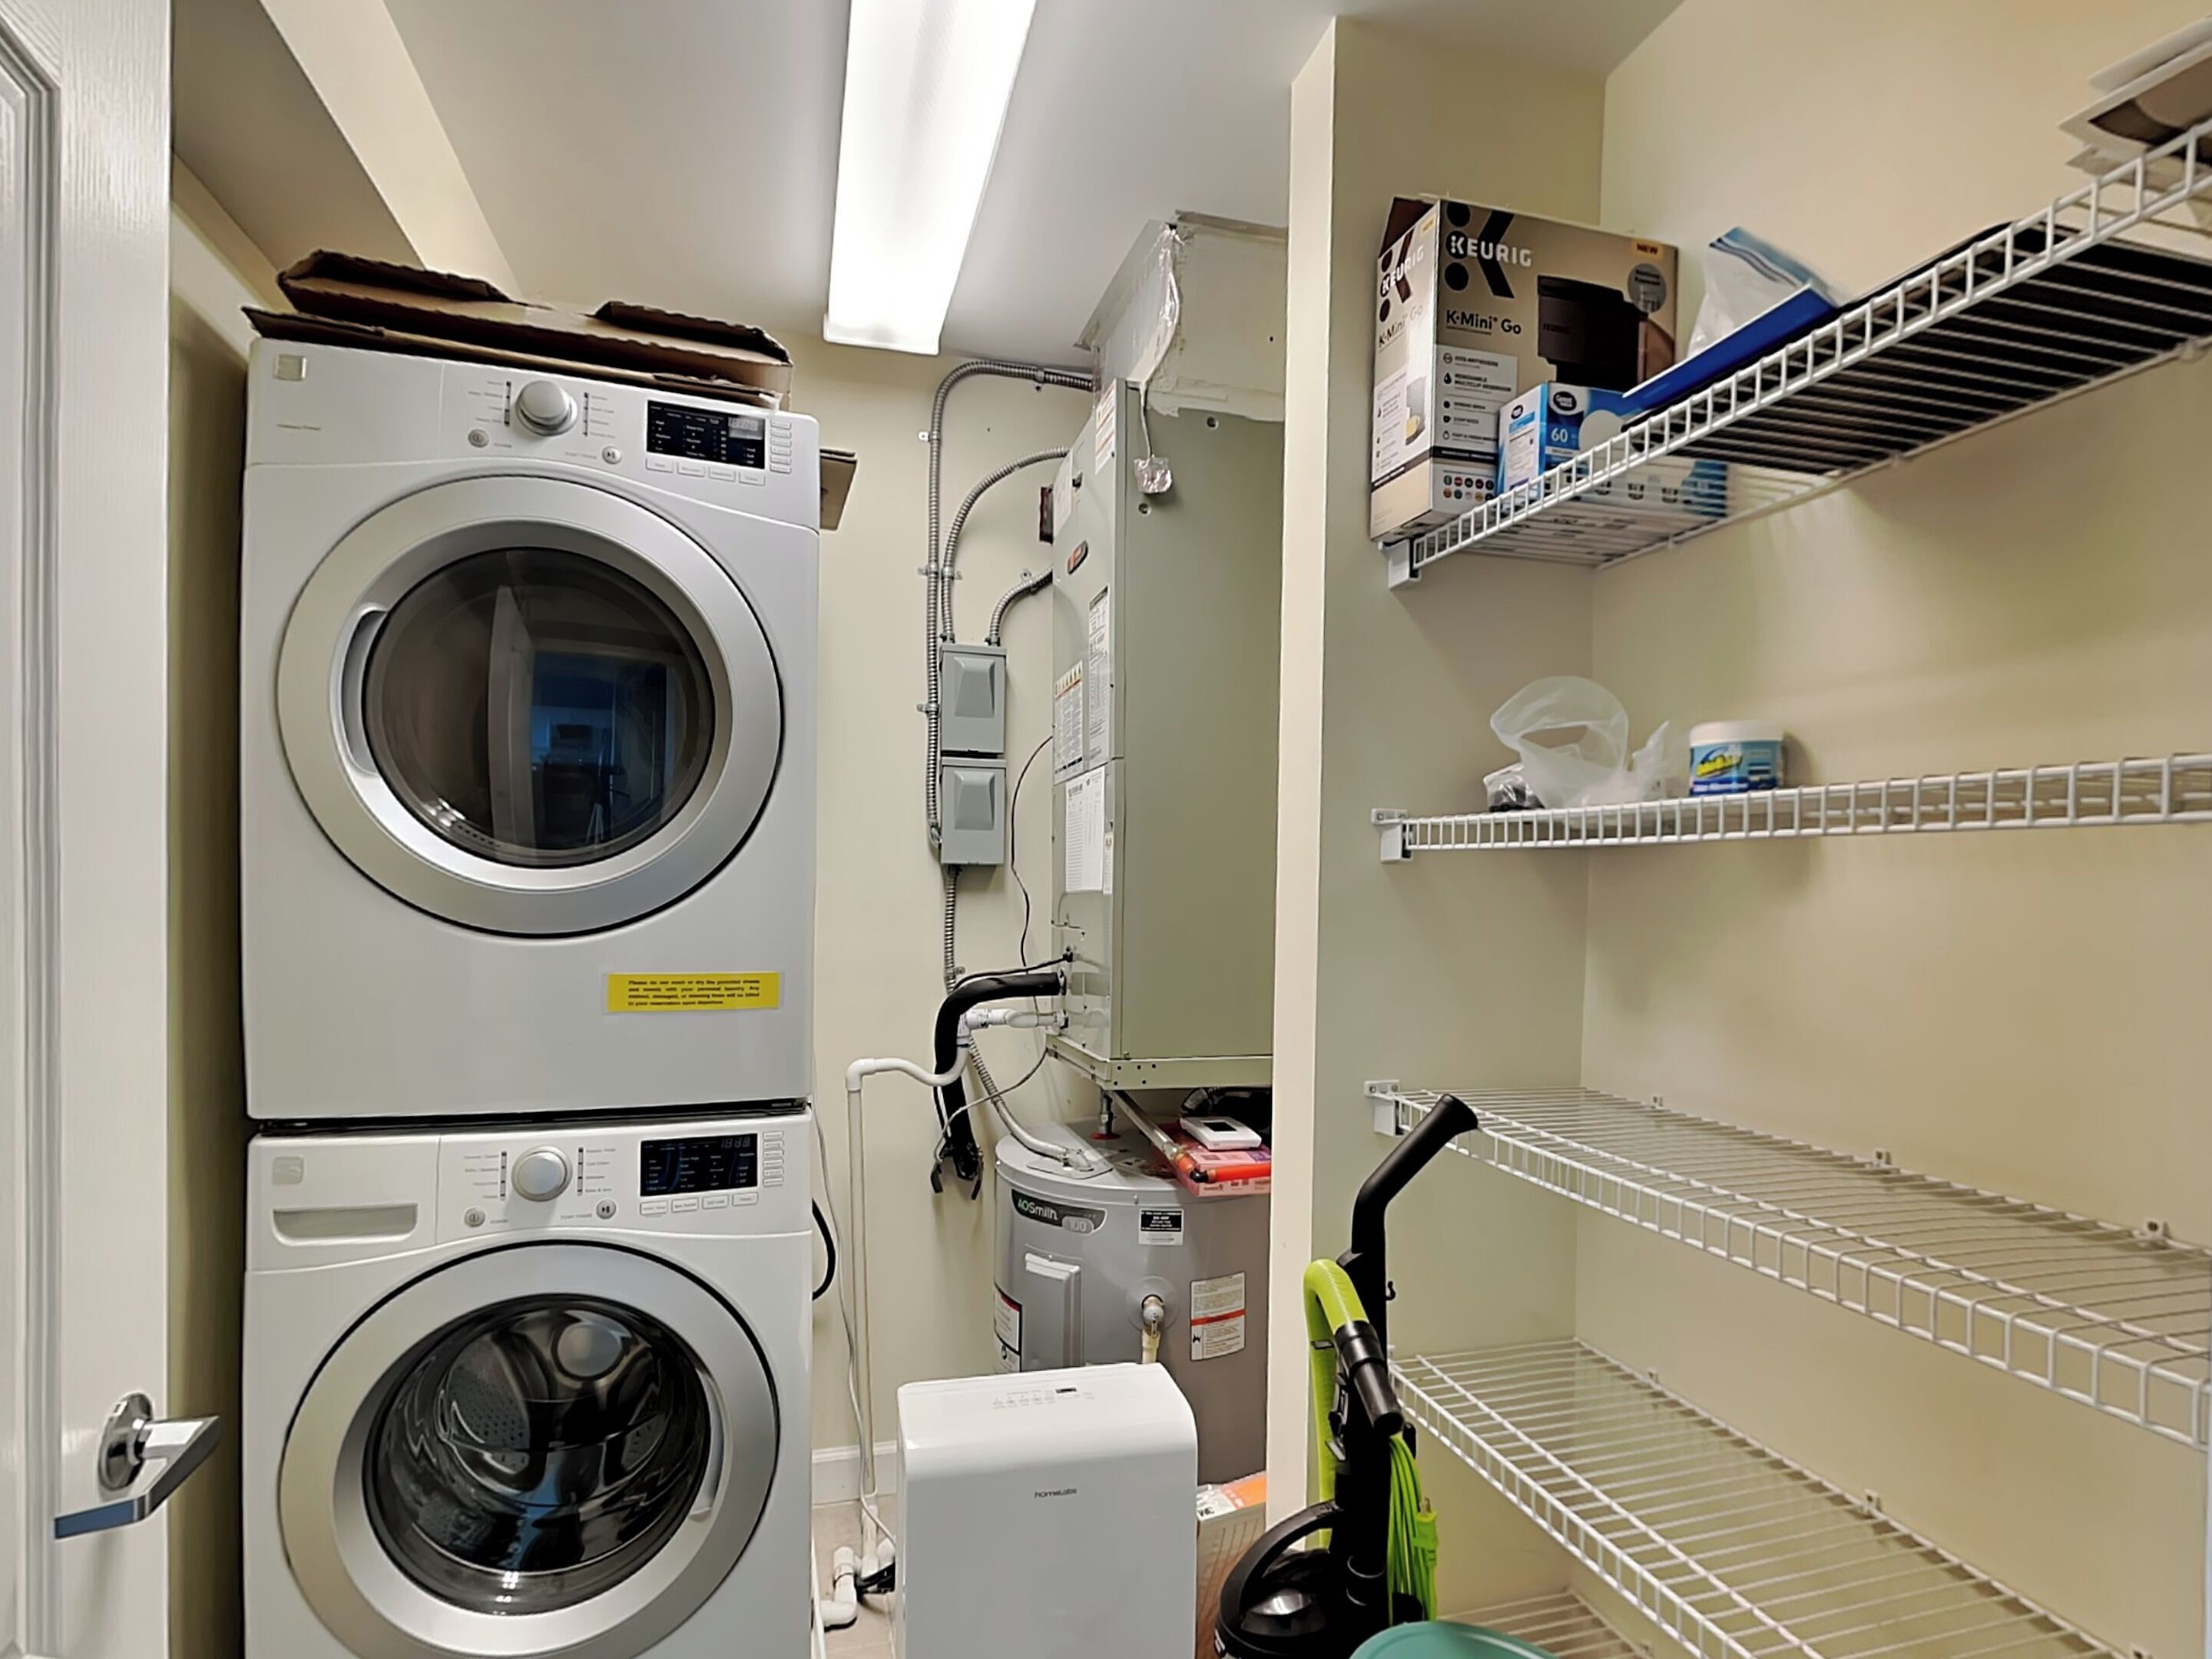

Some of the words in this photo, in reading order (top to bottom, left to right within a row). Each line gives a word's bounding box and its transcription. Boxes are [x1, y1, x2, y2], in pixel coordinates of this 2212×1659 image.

[1451, 235, 1532, 267] KEURIG
[1382, 245, 1424, 294] KEURIG
[1500, 318, 1522, 335] Go
[1551, 427, 1568, 443] 60
